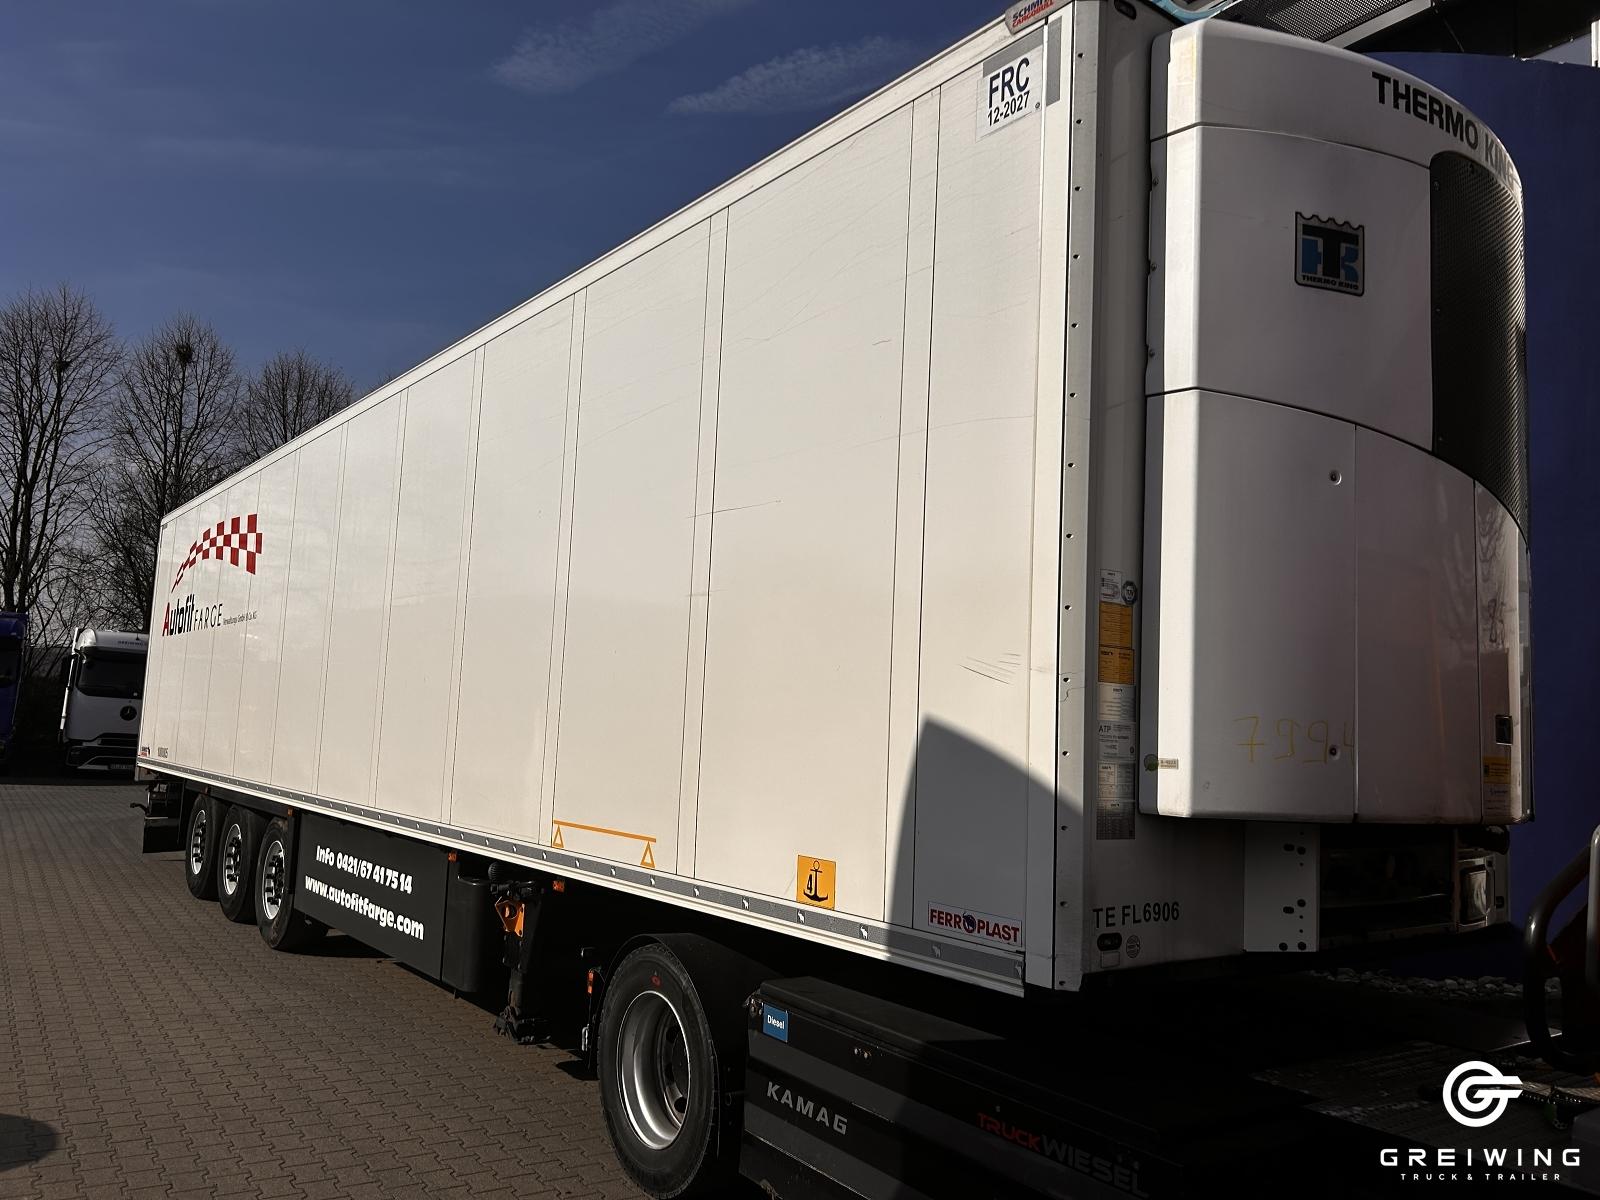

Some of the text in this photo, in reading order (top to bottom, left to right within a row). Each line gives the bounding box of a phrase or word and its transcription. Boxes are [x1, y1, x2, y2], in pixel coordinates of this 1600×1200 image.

[989, 57, 1030, 109] FRC
[988, 91, 1030, 126] 12-2027
[1372, 71, 1479, 150] THERMO
[1302, 274, 1359, 291] THERMO KING
[162, 594, 195, 637] Autofit
[194, 603, 223, 631] FARGE
[316, 845, 335, 867] Info
[336, 852, 373, 878] 0421/67
[400, 873, 413, 895] 14
[305, 875, 424, 940] www.autofitfarge.com
[930, 908, 1020, 943] FERROPLAST
[1092, 907, 1116, 928] TE
[767, 1014, 785, 1030] Diesel
[766, 1081, 848, 1136] KAMAG
